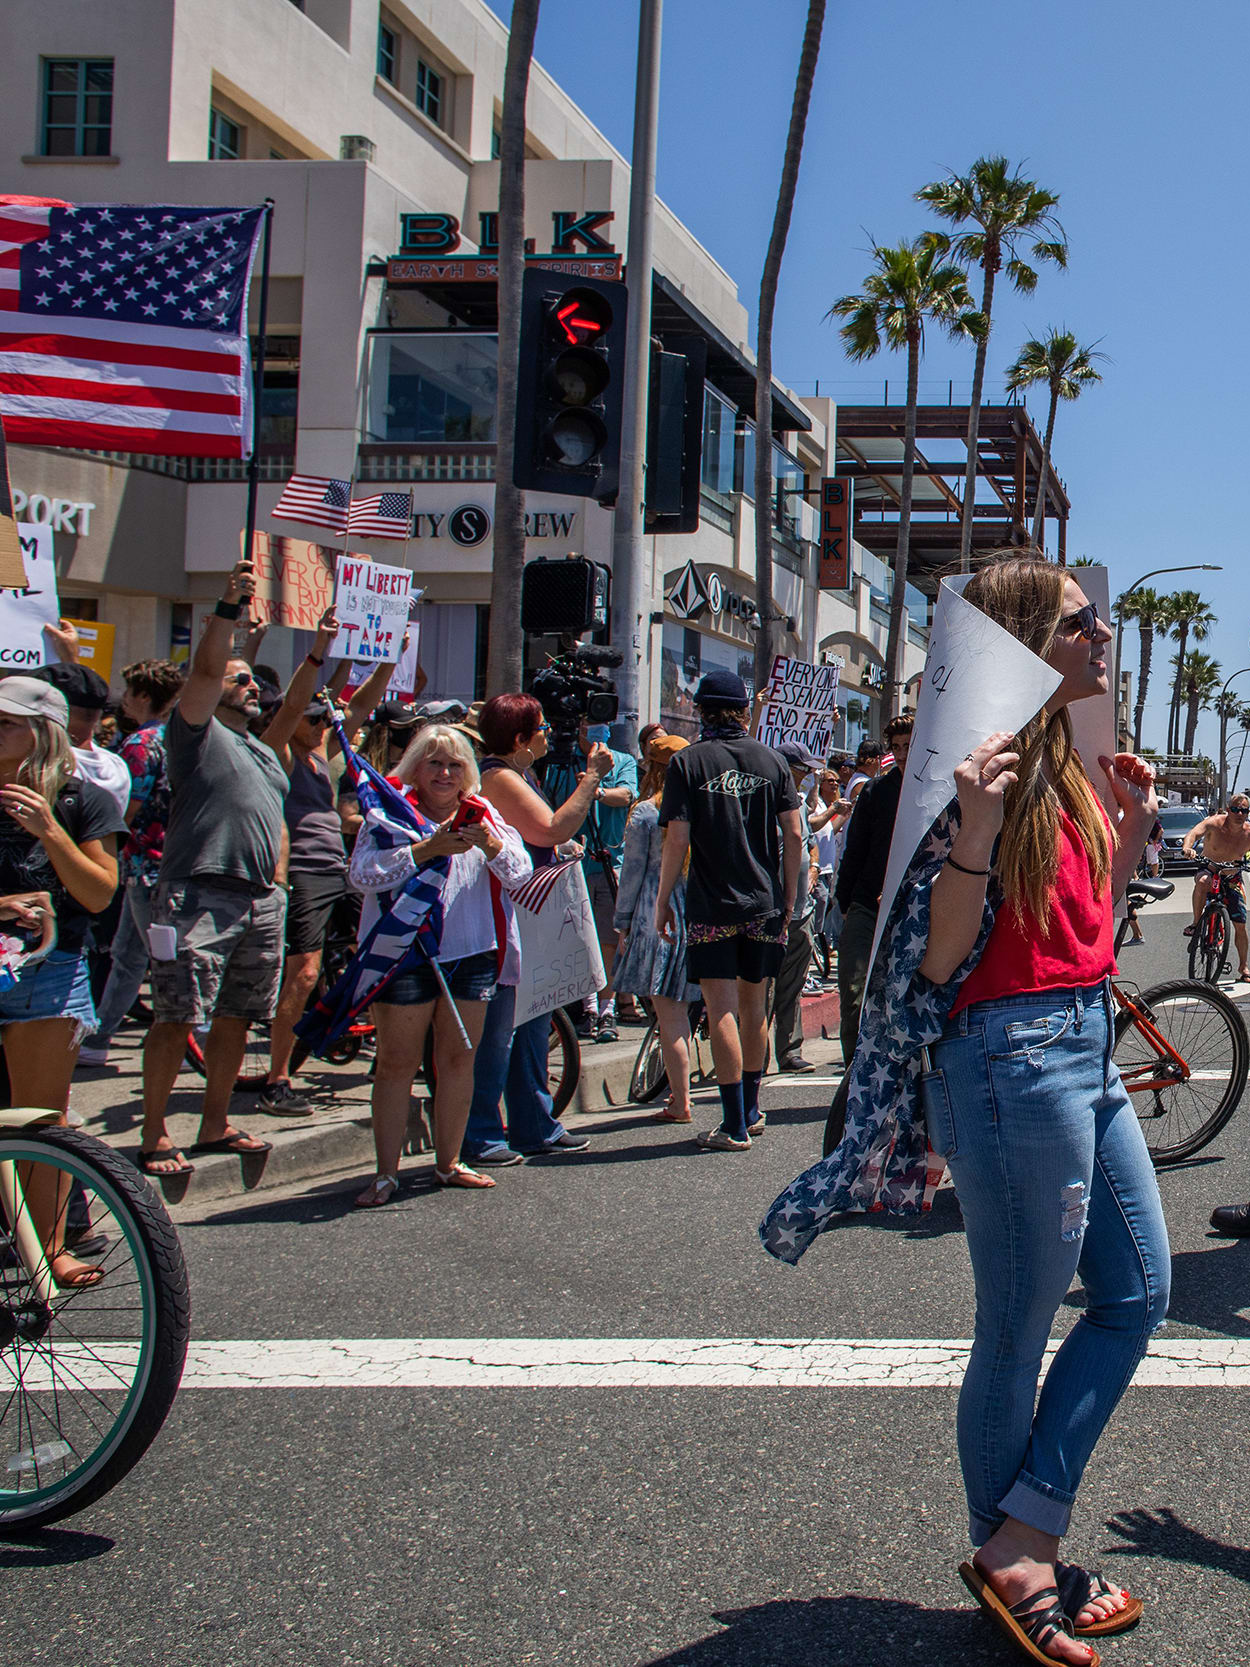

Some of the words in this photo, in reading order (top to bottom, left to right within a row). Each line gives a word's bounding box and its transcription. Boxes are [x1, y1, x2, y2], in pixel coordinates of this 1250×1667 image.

[823, 483, 844, 559] BLK
[342, 563, 363, 588] MY
[299, 586, 328, 609] BUT
[367, 613, 382, 630] TO
[342, 622, 393, 658] TAKE
[769, 680, 836, 711] ESSENTIA
[766, 704, 799, 729] END
[803, 710, 831, 731] THE
